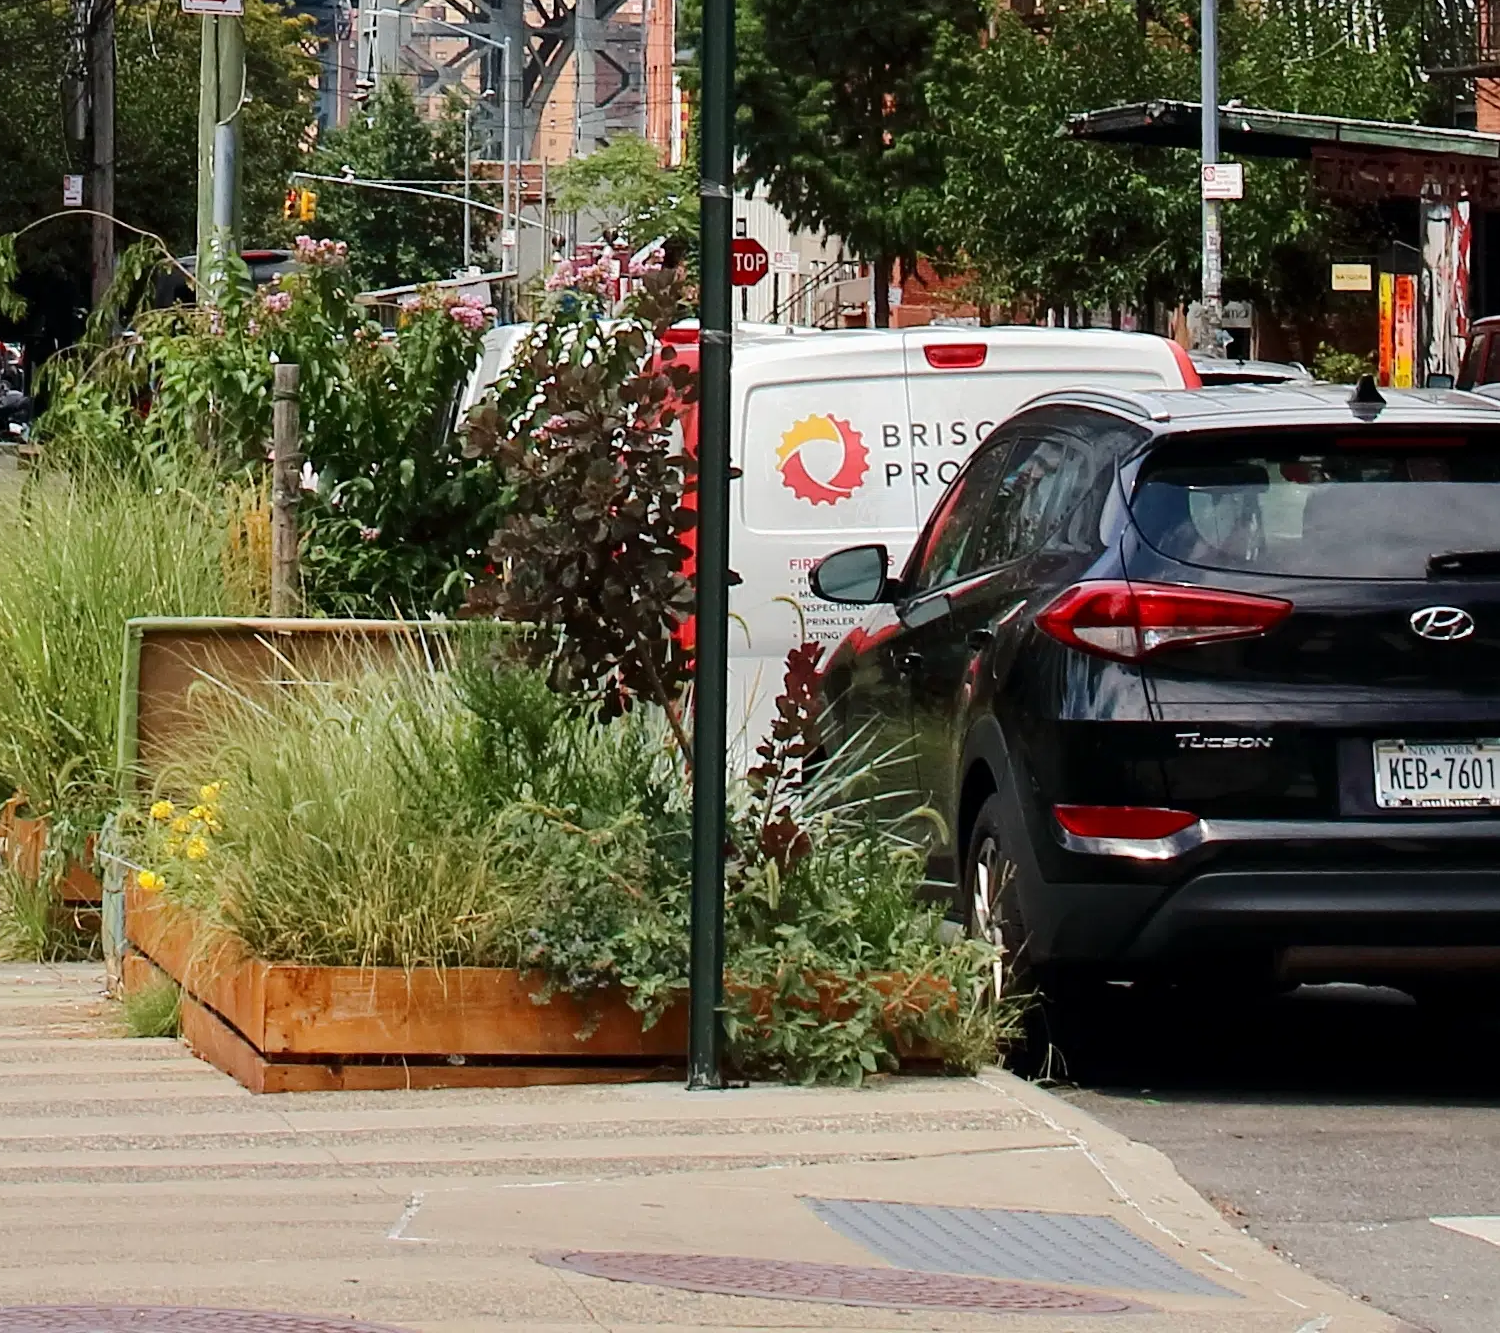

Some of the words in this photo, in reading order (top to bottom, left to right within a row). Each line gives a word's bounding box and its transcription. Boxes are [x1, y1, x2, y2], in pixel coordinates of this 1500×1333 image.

[732, 252, 767, 272] TOP
[803, 602, 867, 613] NSPECTIONS
[806, 616, 856, 627] PRINKLER
[1174, 732, 1274, 749] TUCSON
[1407, 745, 1438, 756] NEW
[1439, 745, 1475, 756] YORK
[1388, 757, 1429, 790] KEB
[1443, 757, 1496, 790] 7601
